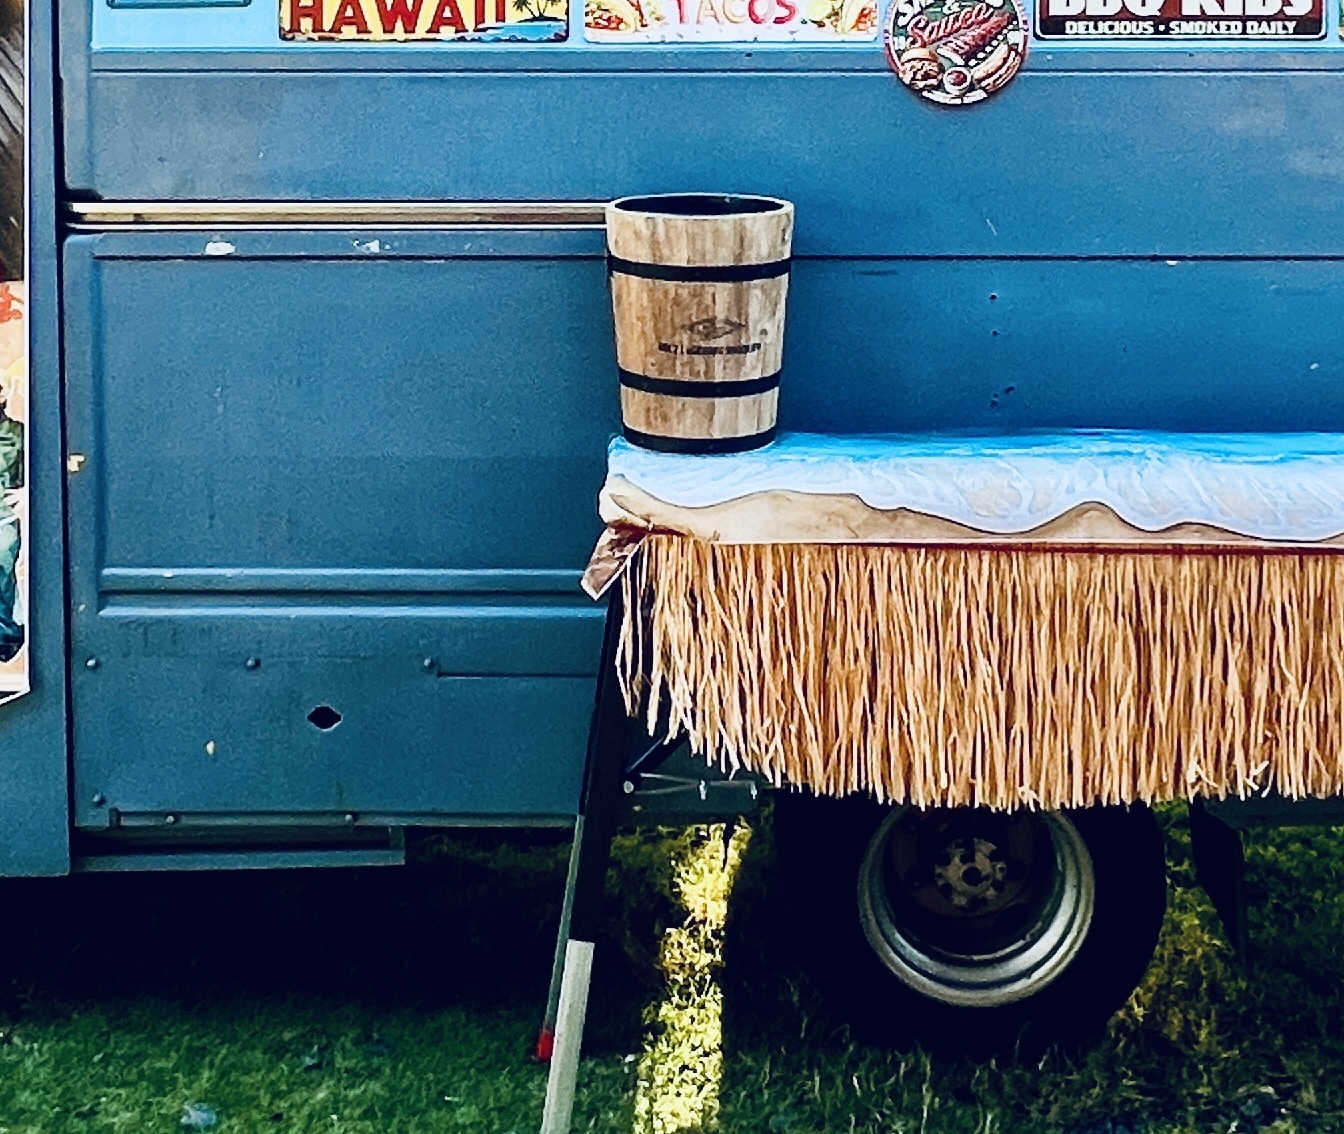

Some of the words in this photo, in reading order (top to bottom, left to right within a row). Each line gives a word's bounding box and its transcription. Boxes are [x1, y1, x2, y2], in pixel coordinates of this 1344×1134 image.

[1064, 20, 1155, 35] DELICIOUS
[1168, 20, 1243, 35] SMOKED
[1246, 20, 1297, 35] DAILY
